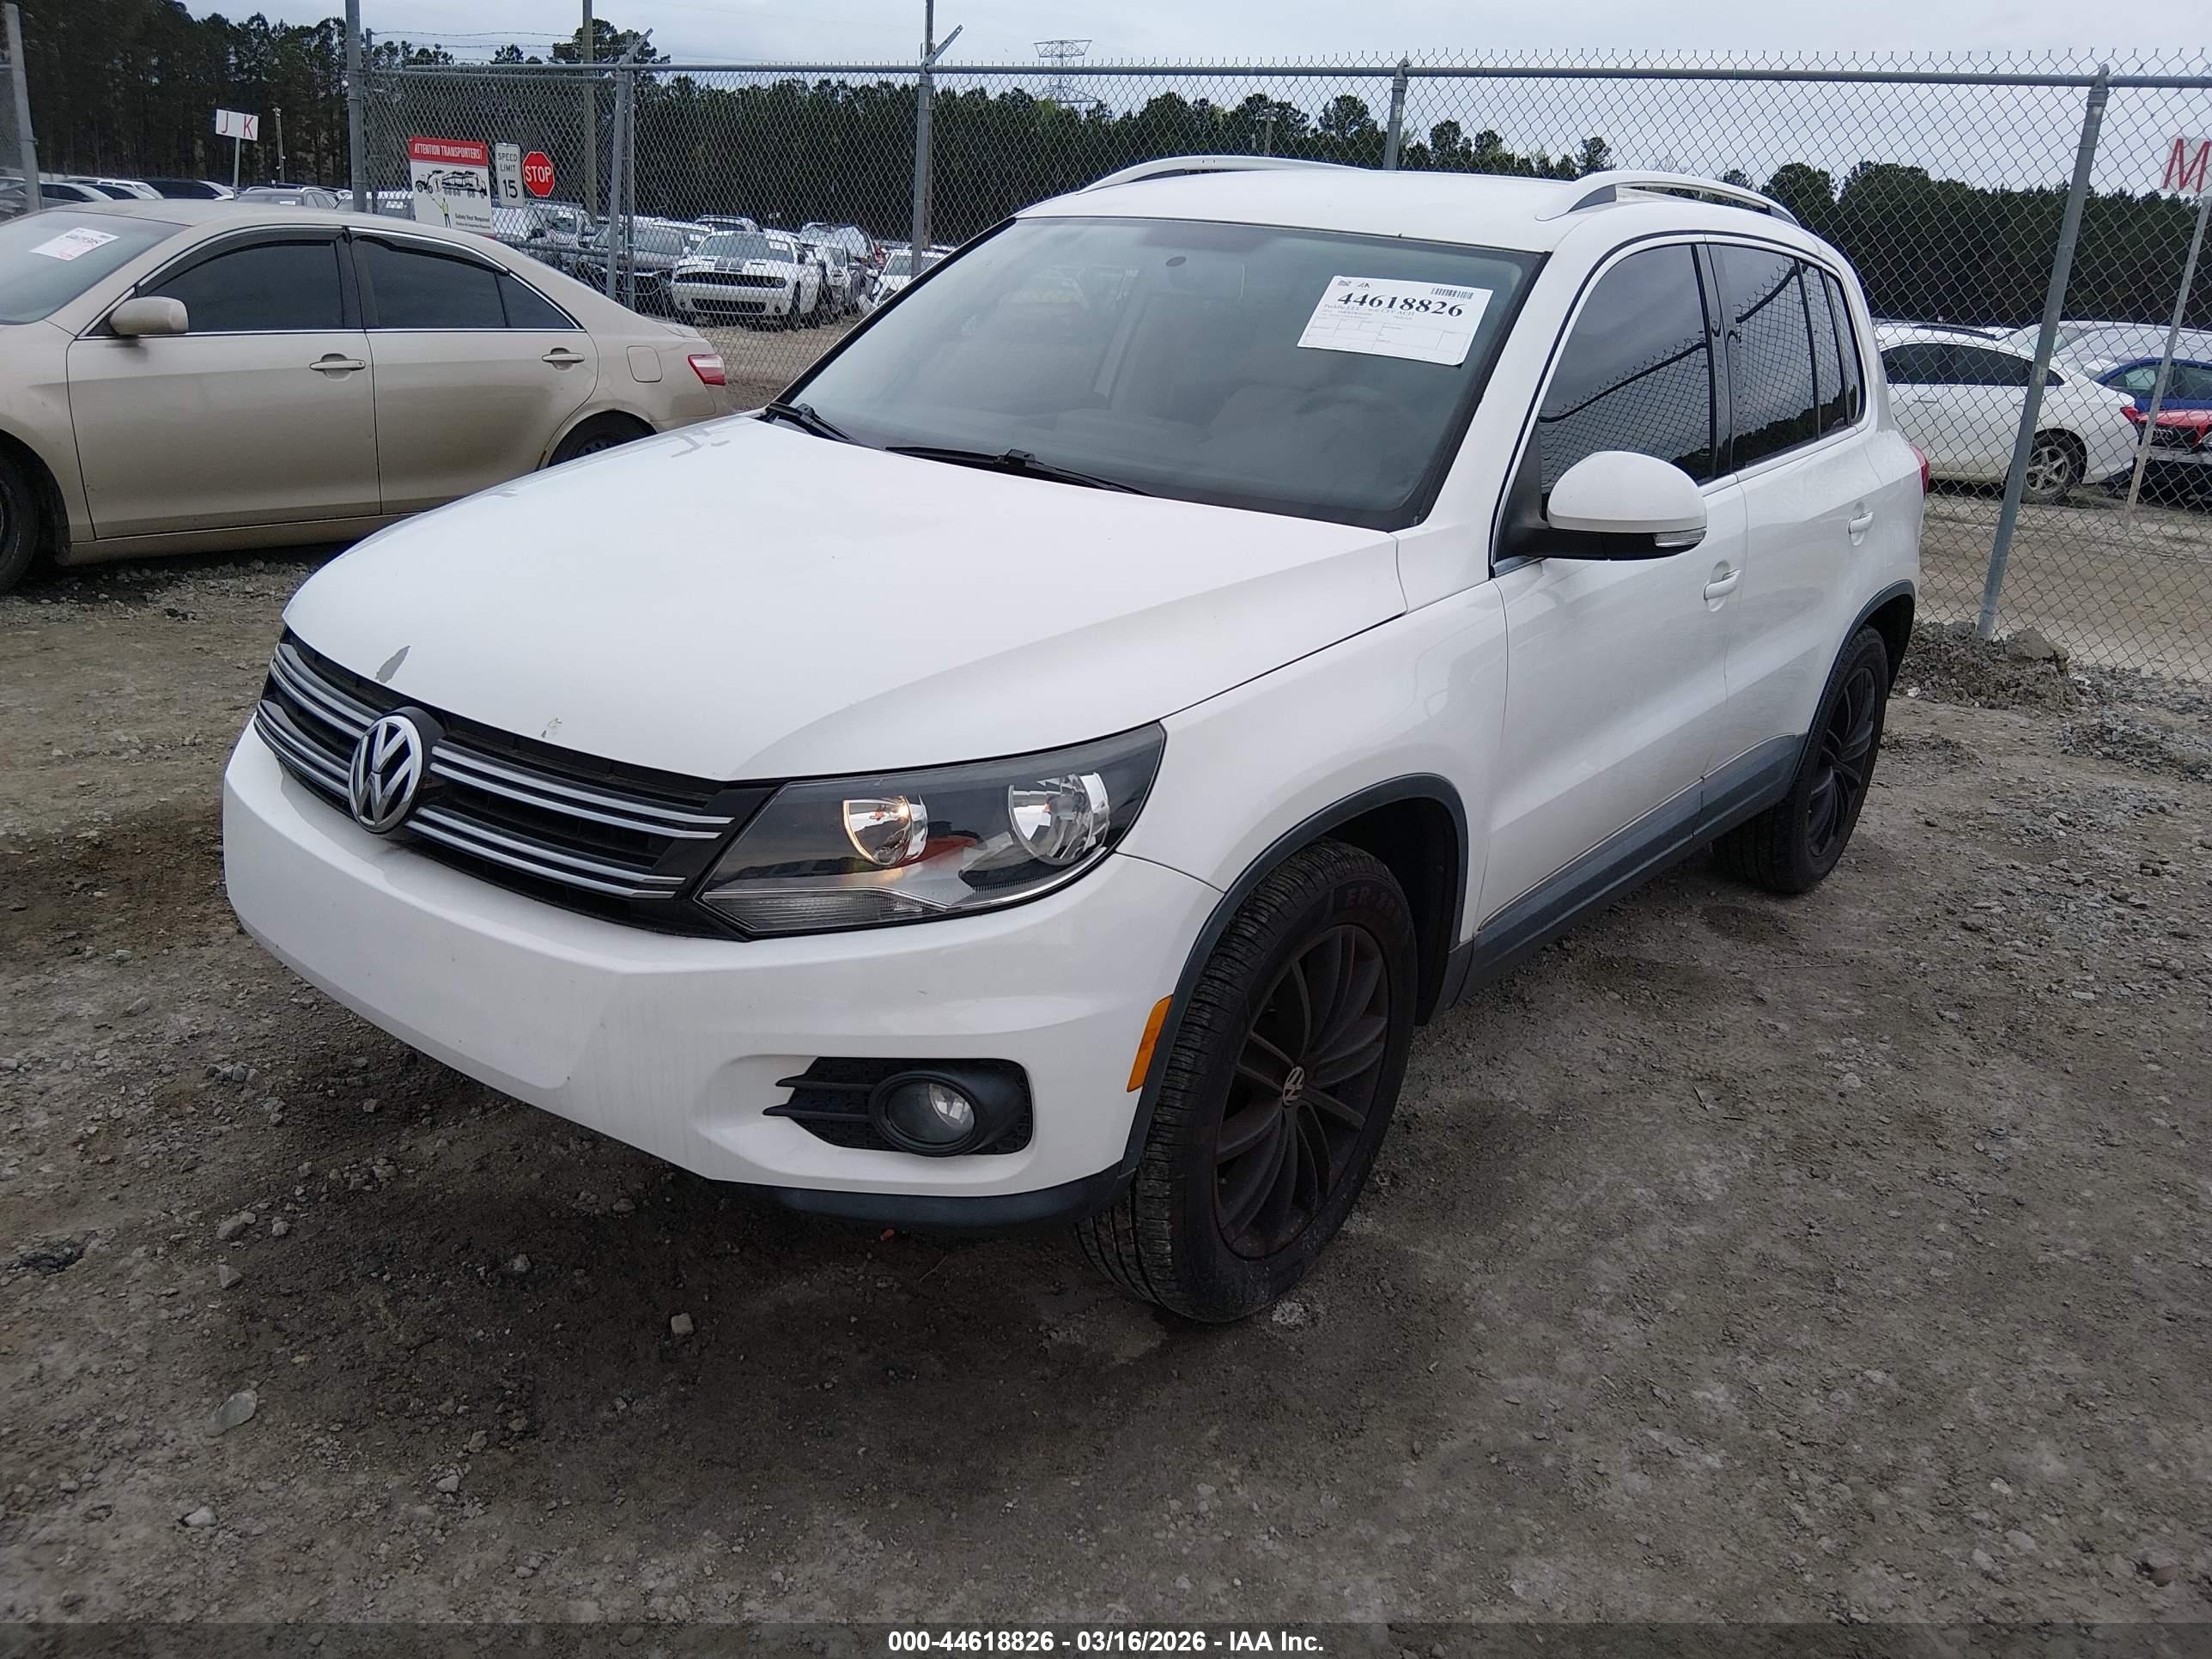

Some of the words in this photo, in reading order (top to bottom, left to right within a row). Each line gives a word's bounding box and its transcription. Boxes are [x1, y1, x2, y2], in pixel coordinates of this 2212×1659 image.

[222, 112, 228, 133] J
[244, 116, 253, 138] K
[415, 143, 440, 155] ATTENTION
[498, 152, 518, 162] SPEED
[500, 163, 516, 173] LIMIT
[525, 165, 552, 184] STOP
[2163, 138, 2210, 192] M
[502, 179, 519, 199] 15
[1337, 292, 1466, 317] 44618826
